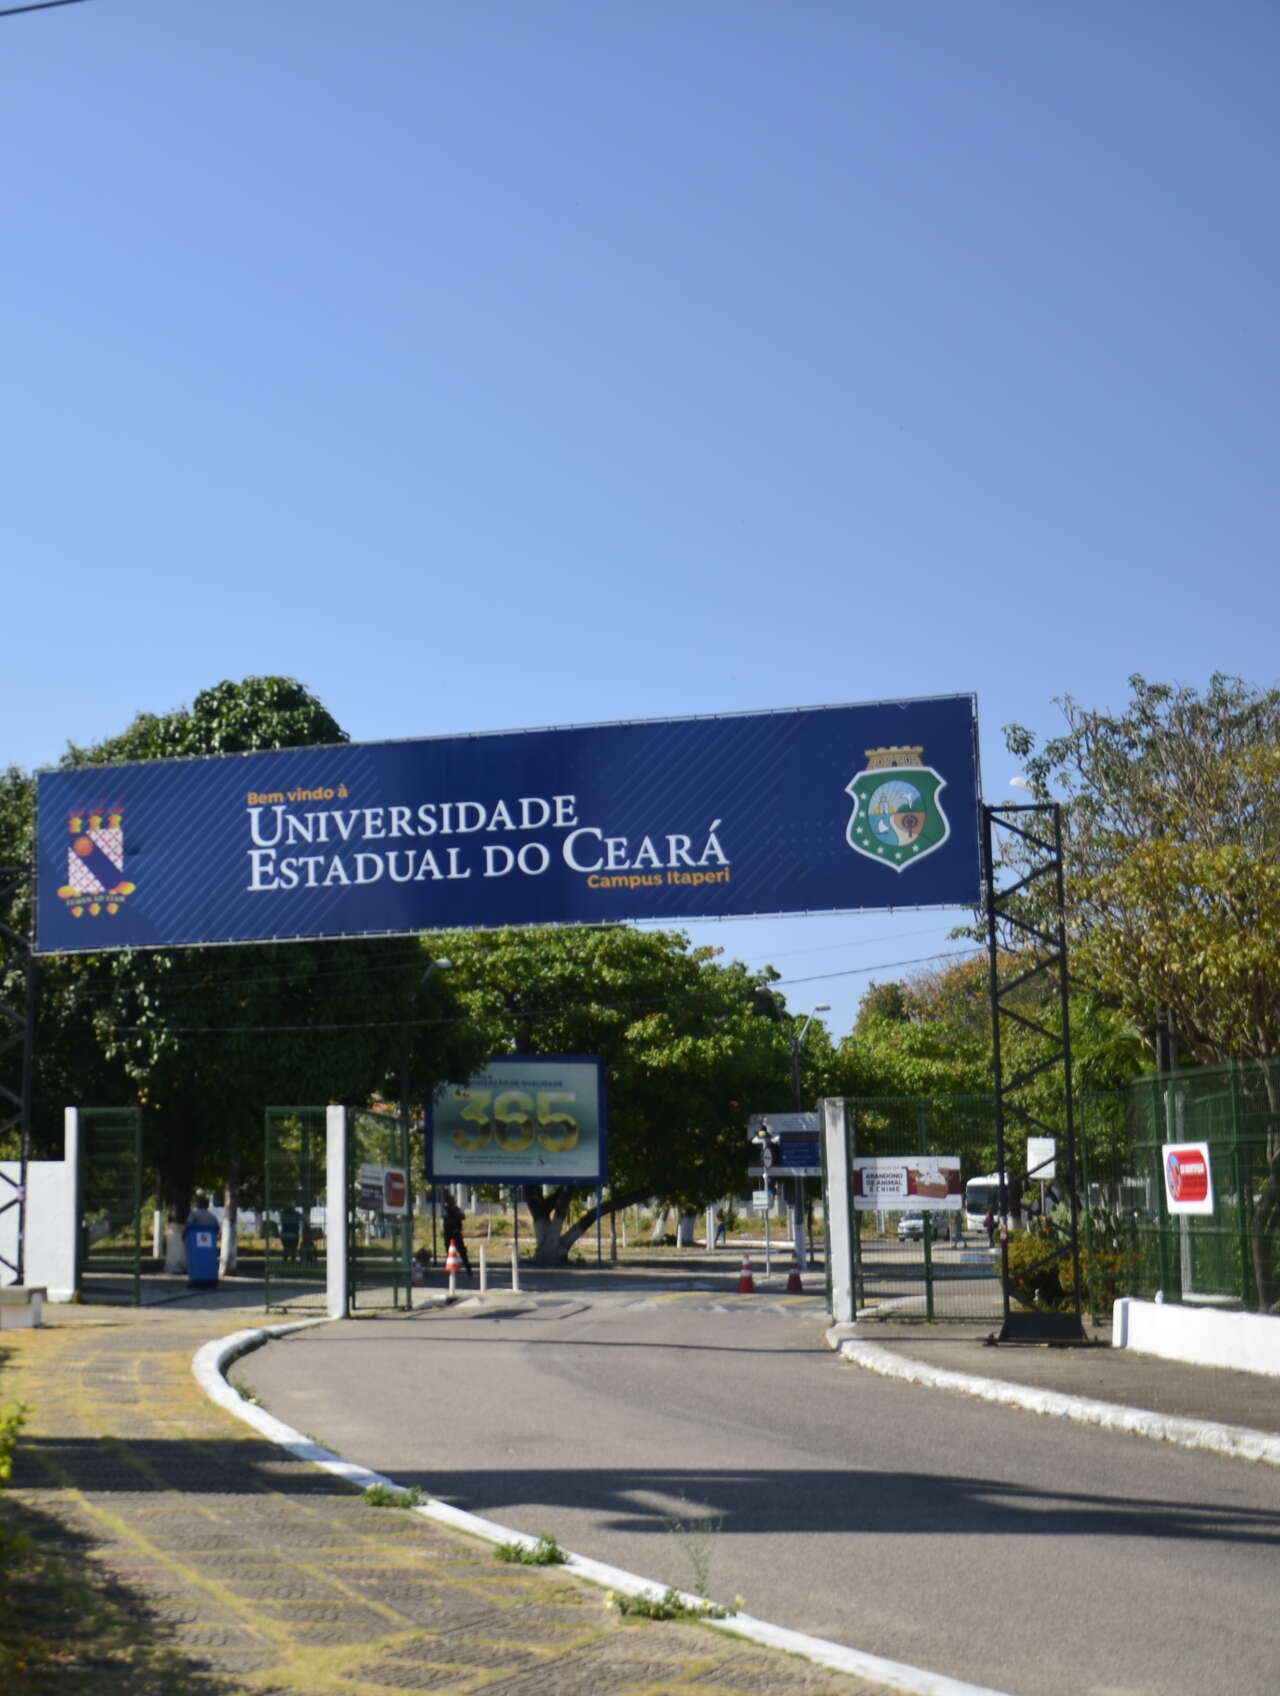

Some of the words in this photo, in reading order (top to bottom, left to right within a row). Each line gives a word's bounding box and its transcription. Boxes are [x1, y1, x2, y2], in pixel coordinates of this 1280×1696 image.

[247, 792, 284, 806] Bem
[287, 787, 334, 802] vindo
[337, 784, 348, 799] à
[247, 847, 470, 891] ESTADUAL
[483, 843, 550, 877] DO
[562, 818, 730, 872] CEARÁ
[587, 874, 663, 889] Campus
[667, 867, 731, 887] Itaperi
[452, 1090, 580, 1153] 365
